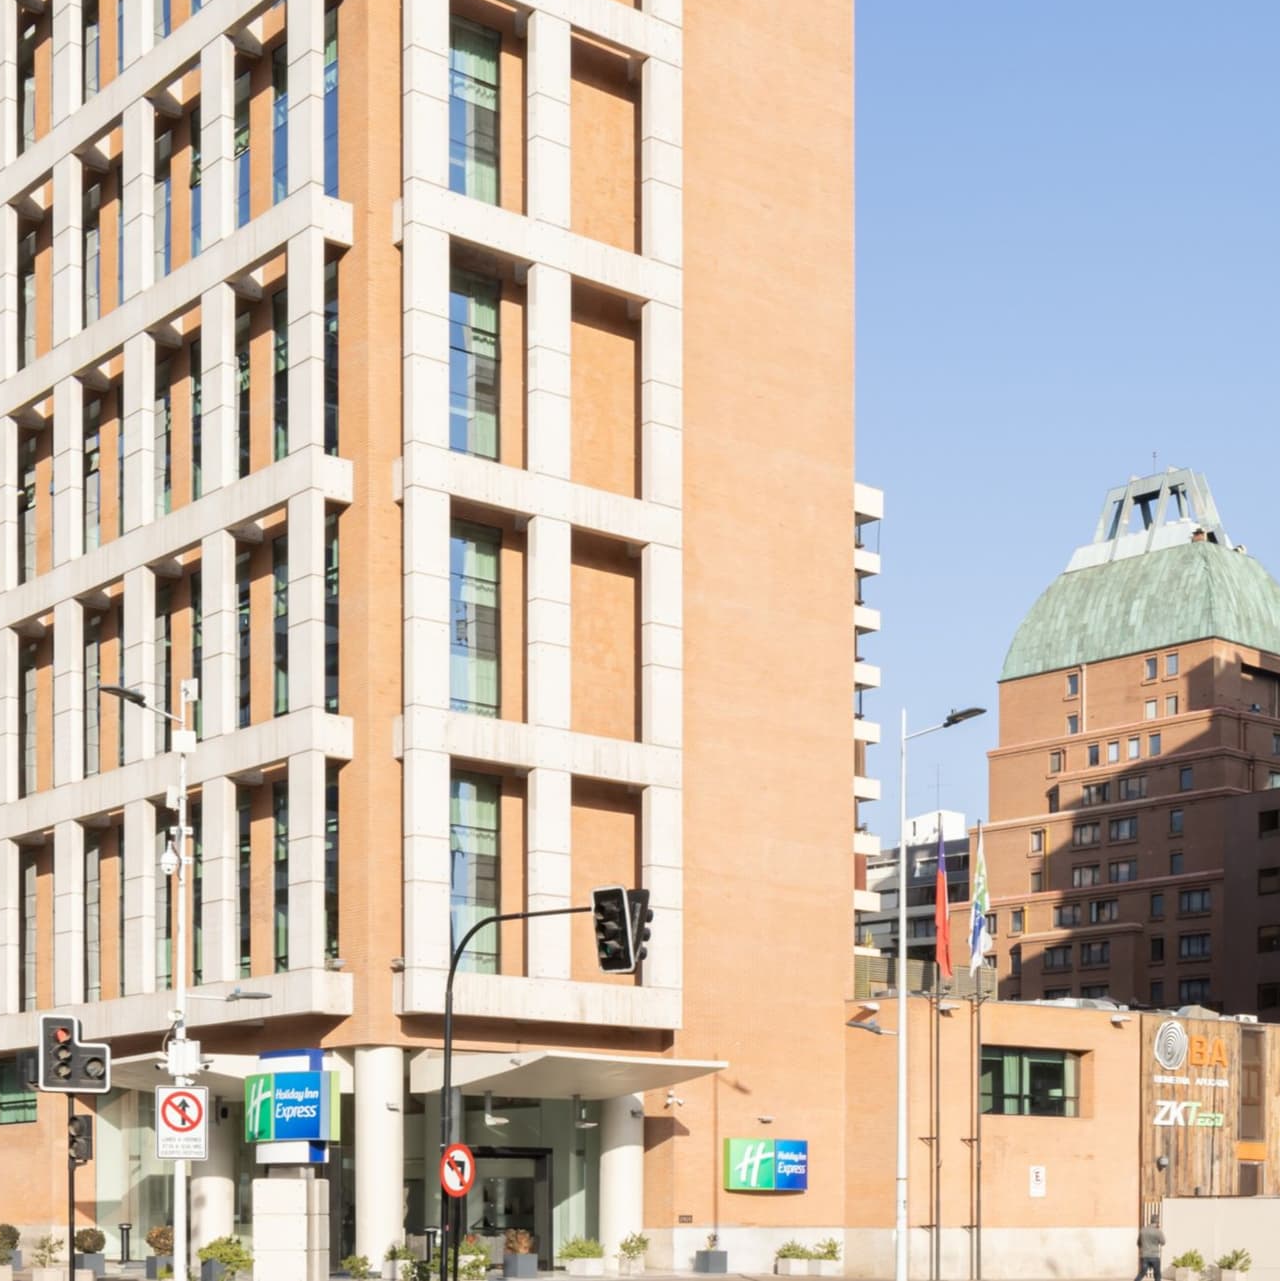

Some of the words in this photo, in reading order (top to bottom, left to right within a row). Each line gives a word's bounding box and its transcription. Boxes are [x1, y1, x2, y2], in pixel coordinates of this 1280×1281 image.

[1190, 1035, 1228, 1068] BA
[275, 1087, 305, 1102] Holiday
[304, 1086, 319, 1099] Inn
[275, 1103, 318, 1122] Express
[777, 1161, 806, 1177] Express
